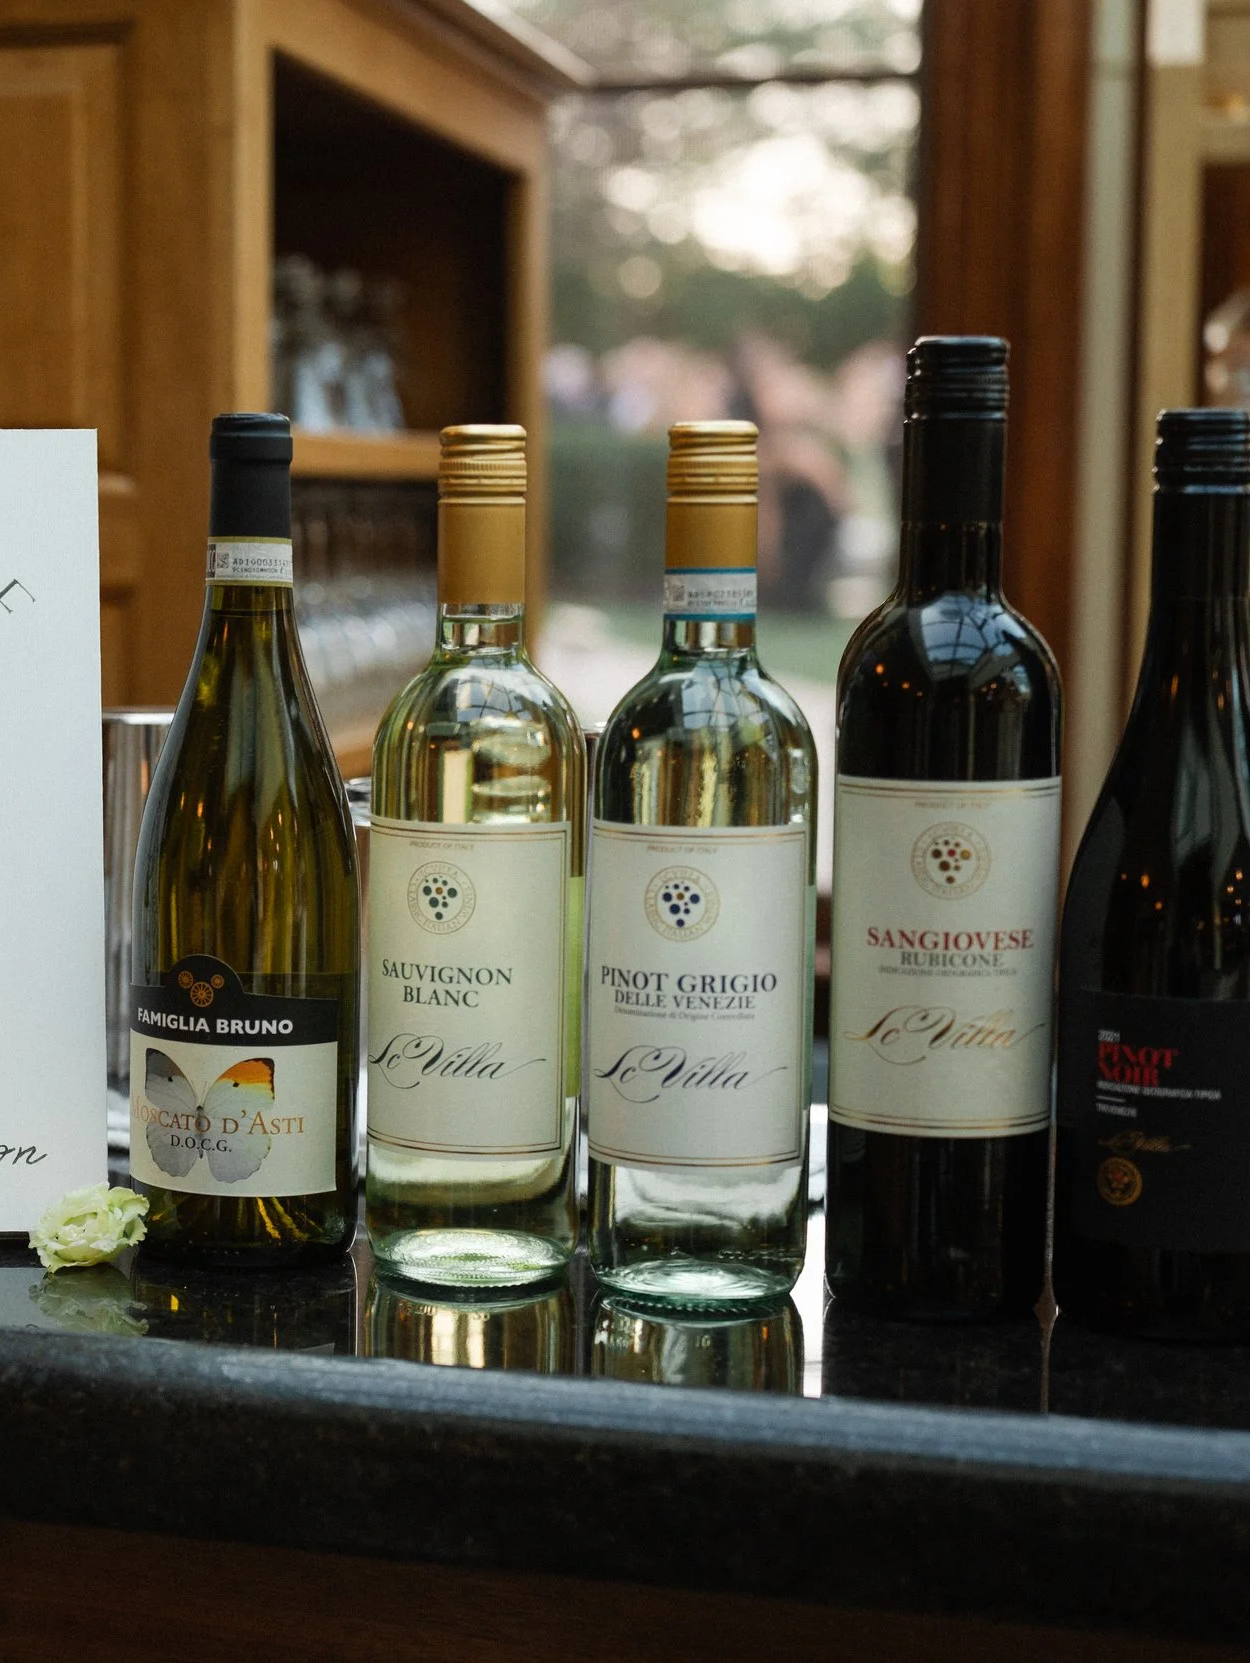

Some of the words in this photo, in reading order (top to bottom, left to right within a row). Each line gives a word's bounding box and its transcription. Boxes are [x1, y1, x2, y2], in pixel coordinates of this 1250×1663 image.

[866, 926, 1034, 952] SANGIOVESE
[382, 959, 513, 986] SAUVIGNON
[900, 951, 1003, 968] RUBICONE
[601, 965, 669, 993] PINOT
[677, 972, 777, 994] GRIGIO
[402, 985, 479, 1009] BLANC
[614, 990, 666, 1009] DELLE
[673, 994, 756, 1010] VENEZIE
[137, 1007, 210, 1033] FAMIGLIA
[216, 1018, 294, 1035] BRUNO
[403, 1034, 547, 1080] Villa
[640, 1046, 788, 1090] Villa
[170, 1134, 232, 1152] D.O.C.G.
